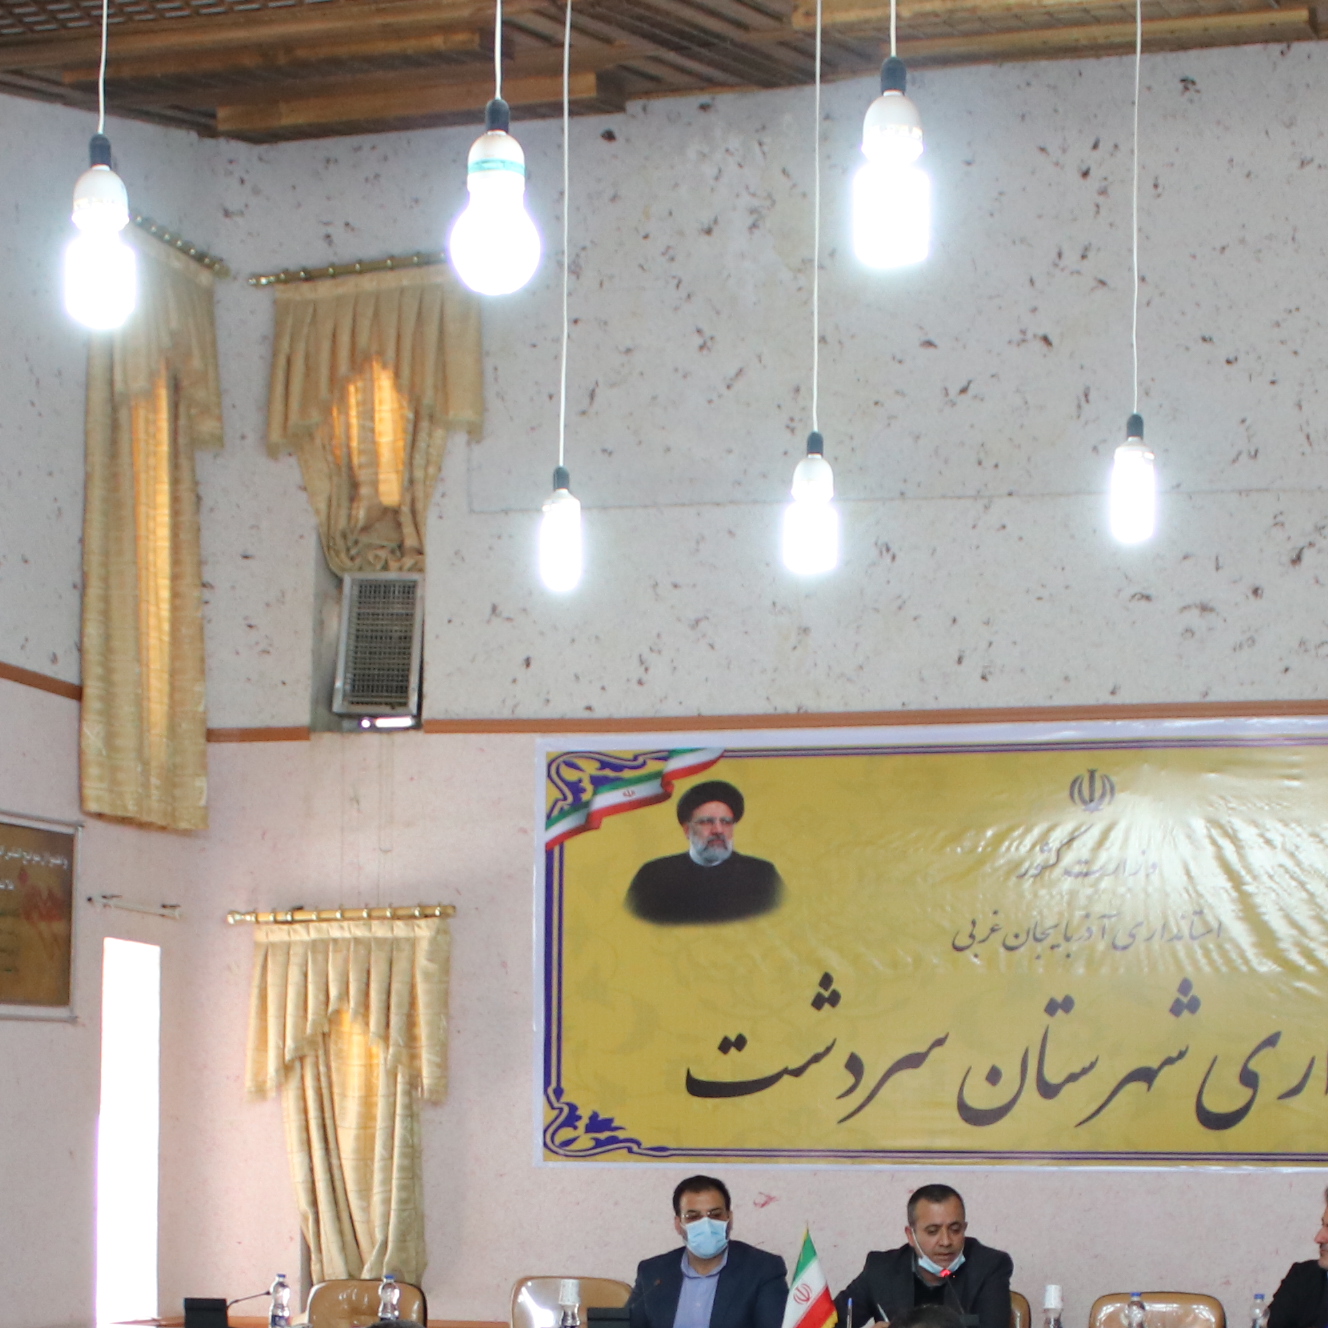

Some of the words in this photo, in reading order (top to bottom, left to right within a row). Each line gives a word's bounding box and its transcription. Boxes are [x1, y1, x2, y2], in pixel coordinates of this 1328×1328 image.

[1063, 848, 1158, 879] وزارت
[951, 909, 1003, 959] غربی
[1002, 911, 1119, 960] آذربایجان
[1111, 908, 1222, 951] استانداری
[684, 971, 950, 1125] سردشت
[957, 976, 1202, 1128] شهرستان
